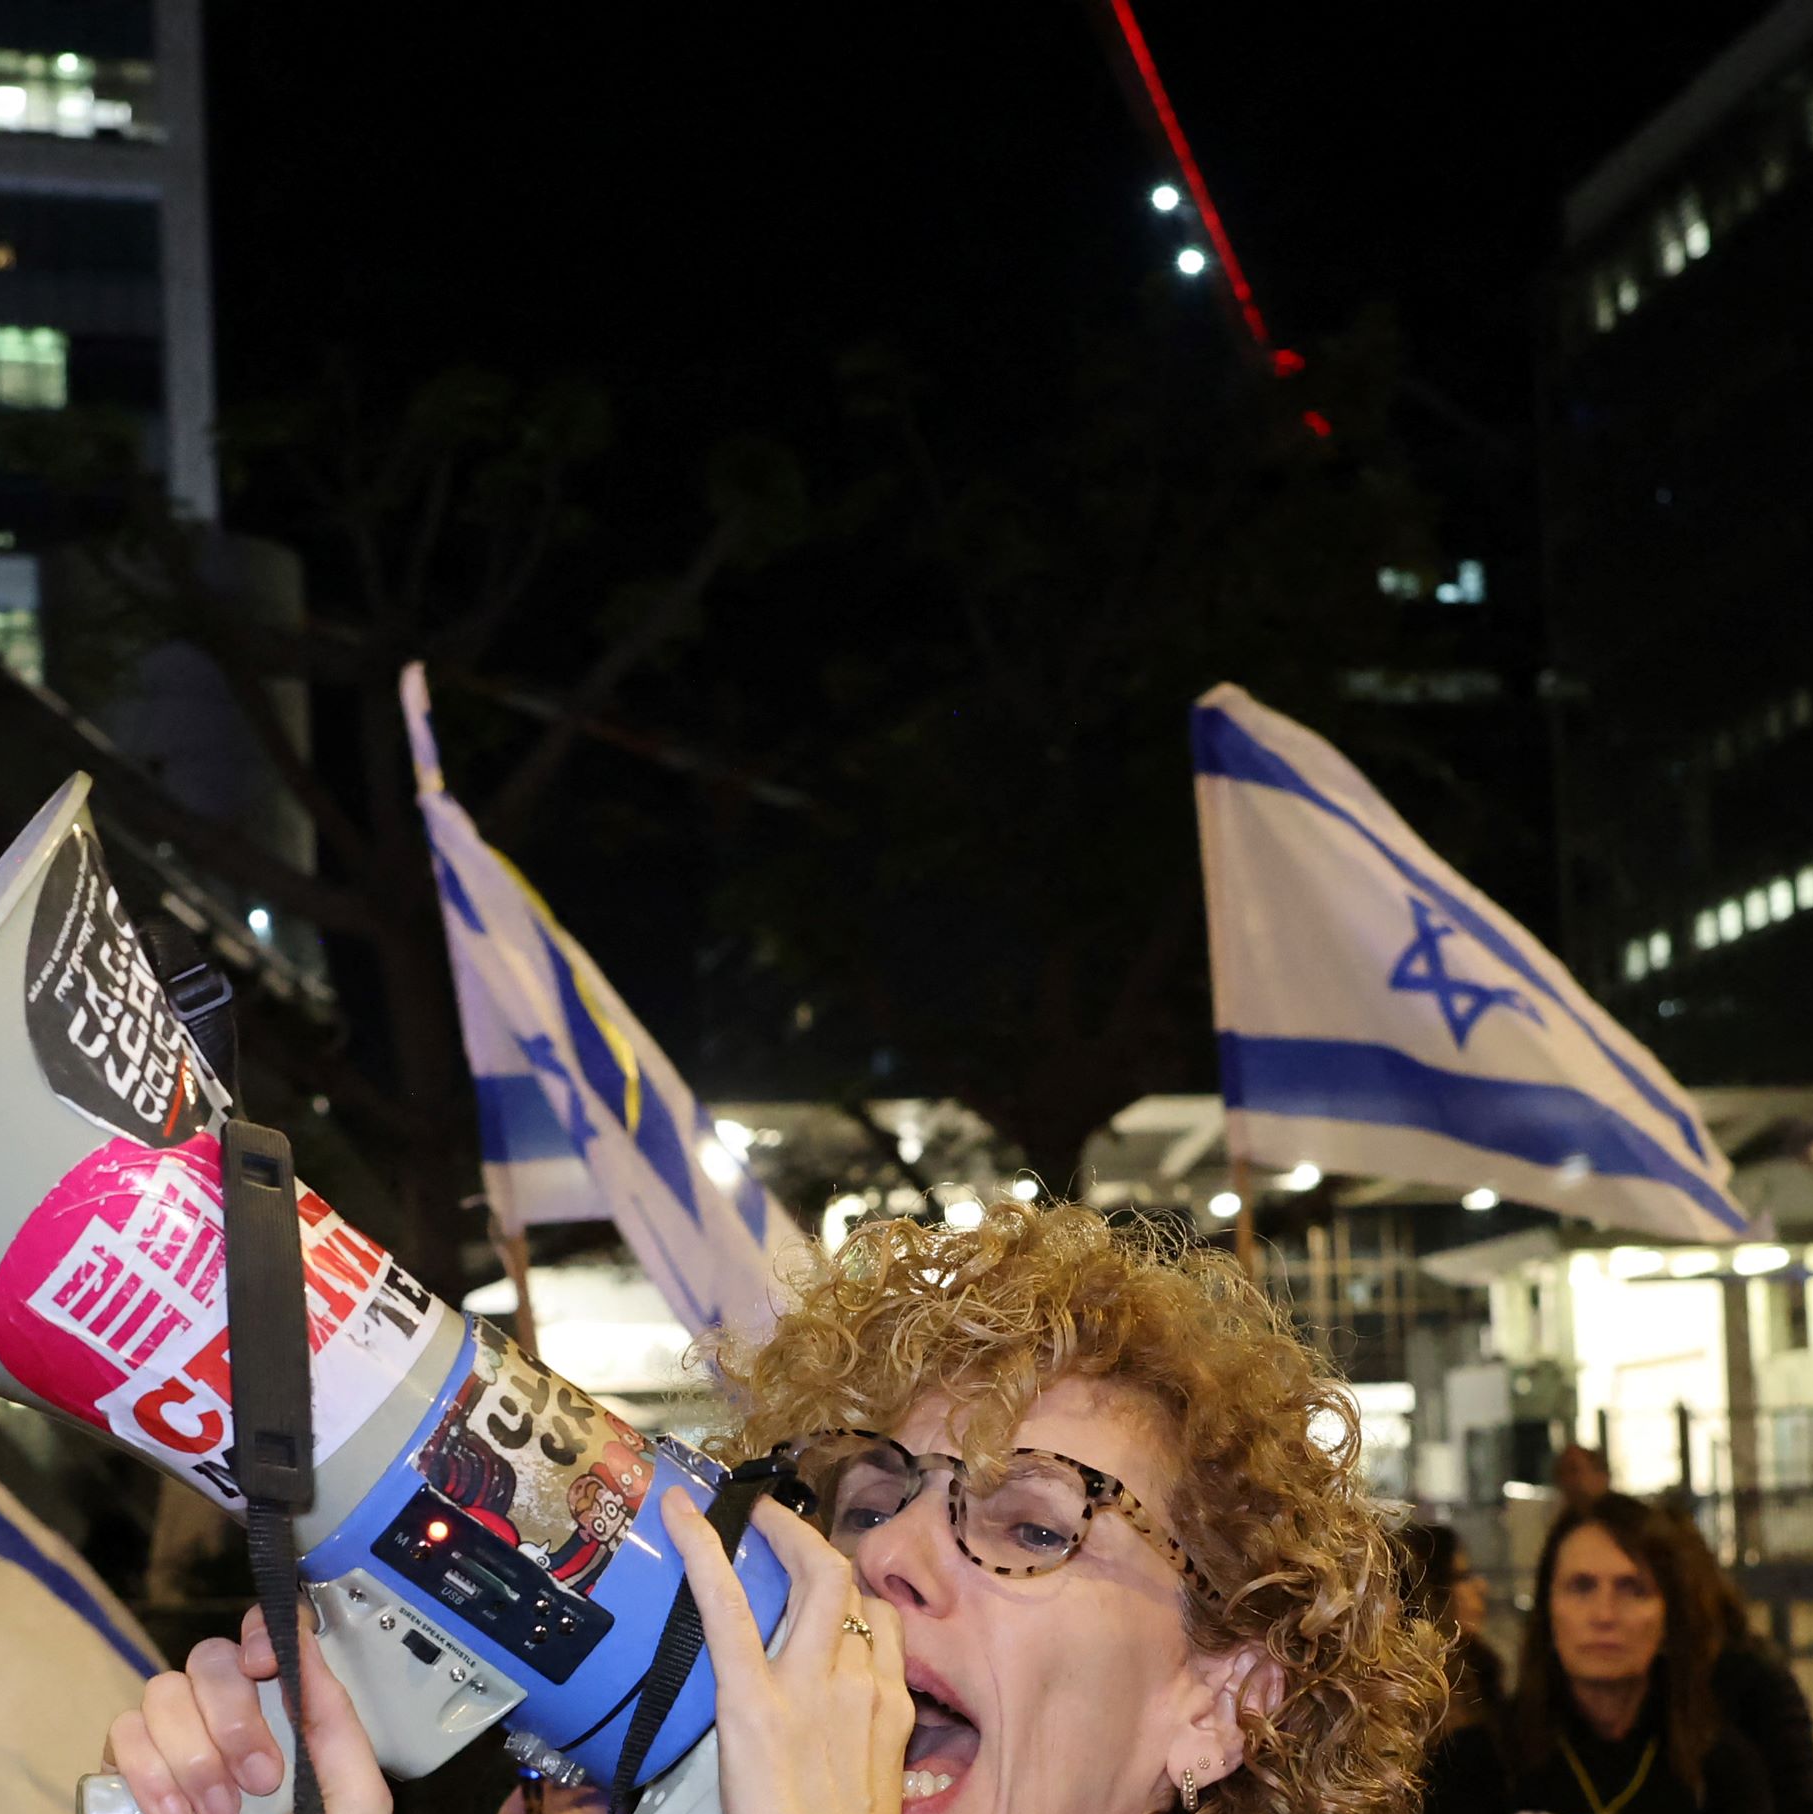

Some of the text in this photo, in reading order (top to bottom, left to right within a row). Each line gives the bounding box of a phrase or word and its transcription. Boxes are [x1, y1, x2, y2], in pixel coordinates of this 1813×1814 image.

[133, 1010, 182, 1125] מסתכ
[440, 1586, 466, 1606] USB
[399, 1607, 477, 1668] SIREN SPEAK WHISTLE
